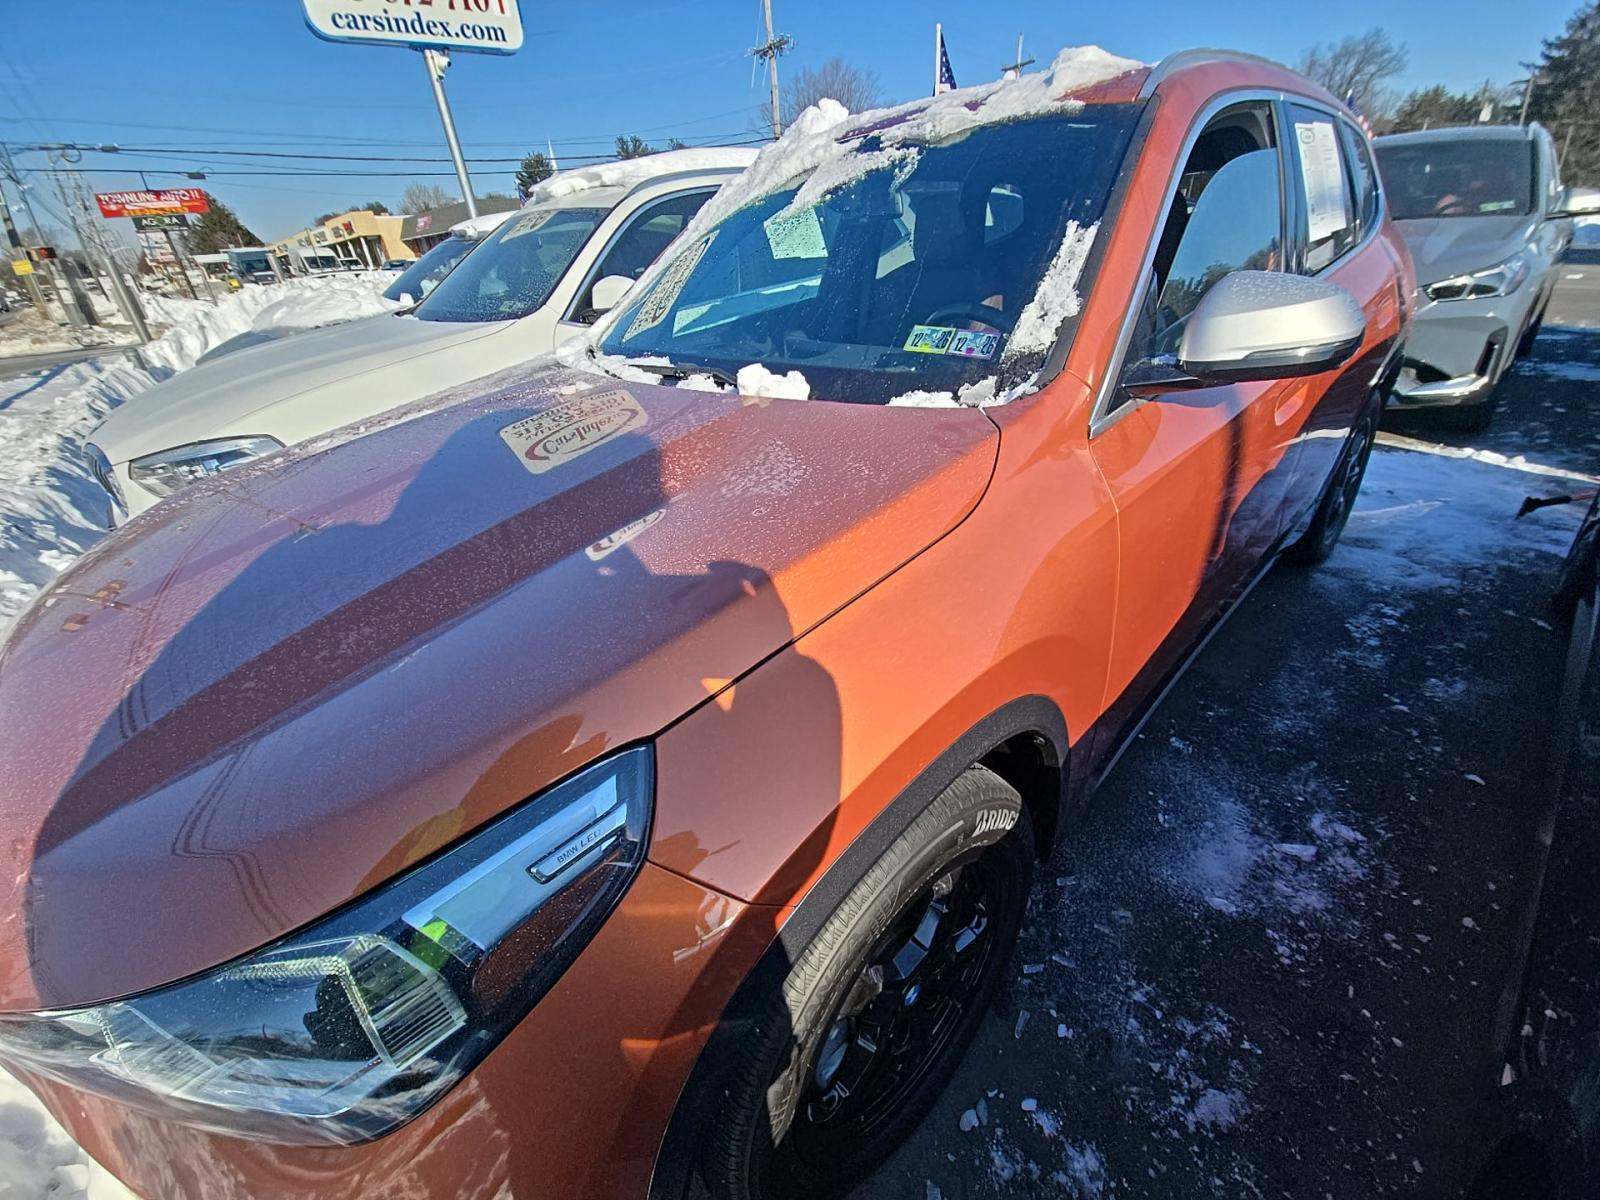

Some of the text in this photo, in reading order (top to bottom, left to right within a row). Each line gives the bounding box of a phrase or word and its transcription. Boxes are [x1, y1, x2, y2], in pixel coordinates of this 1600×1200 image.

[331, 9, 507, 42] carsindex.com
[160, 189, 188, 202] AUTO
[911, 333, 925, 347] 12
[955, 337, 968, 352] 12
[557, 845, 578, 863] BMW
